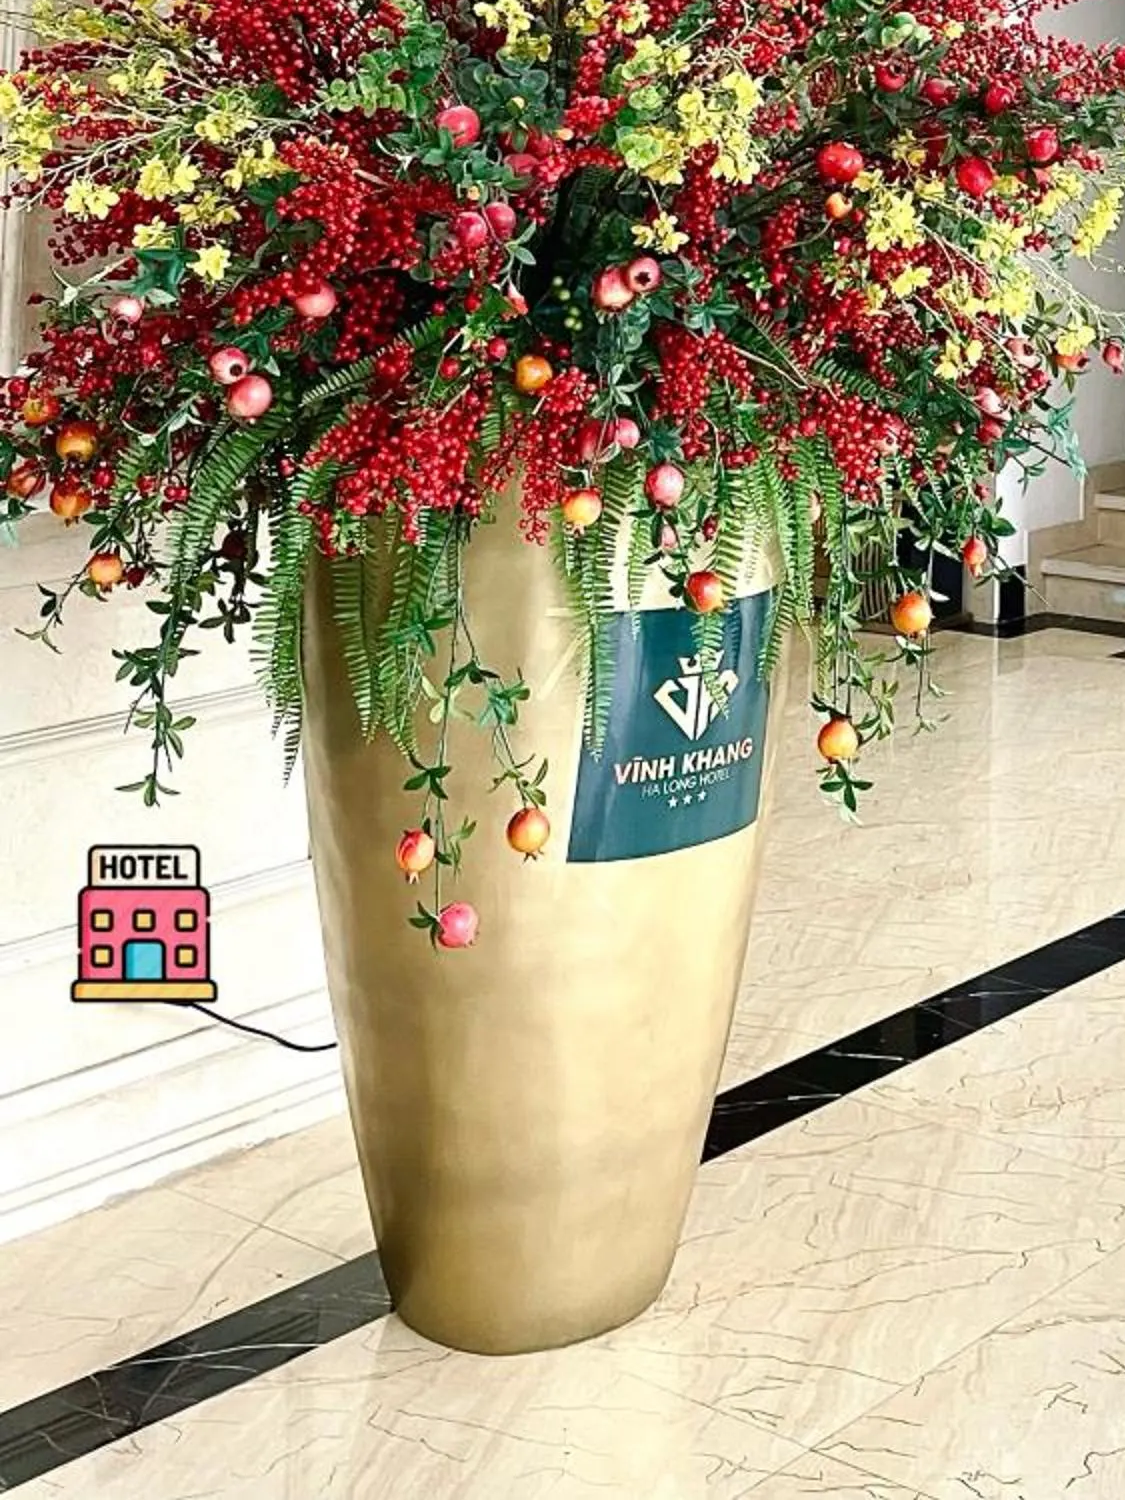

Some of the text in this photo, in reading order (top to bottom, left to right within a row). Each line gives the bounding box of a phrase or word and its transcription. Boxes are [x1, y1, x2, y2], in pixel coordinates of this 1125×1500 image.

[681, 737, 753, 775] KHANG
[663, 775, 697, 795] LONG
[699, 768, 731, 787] HOTEL
